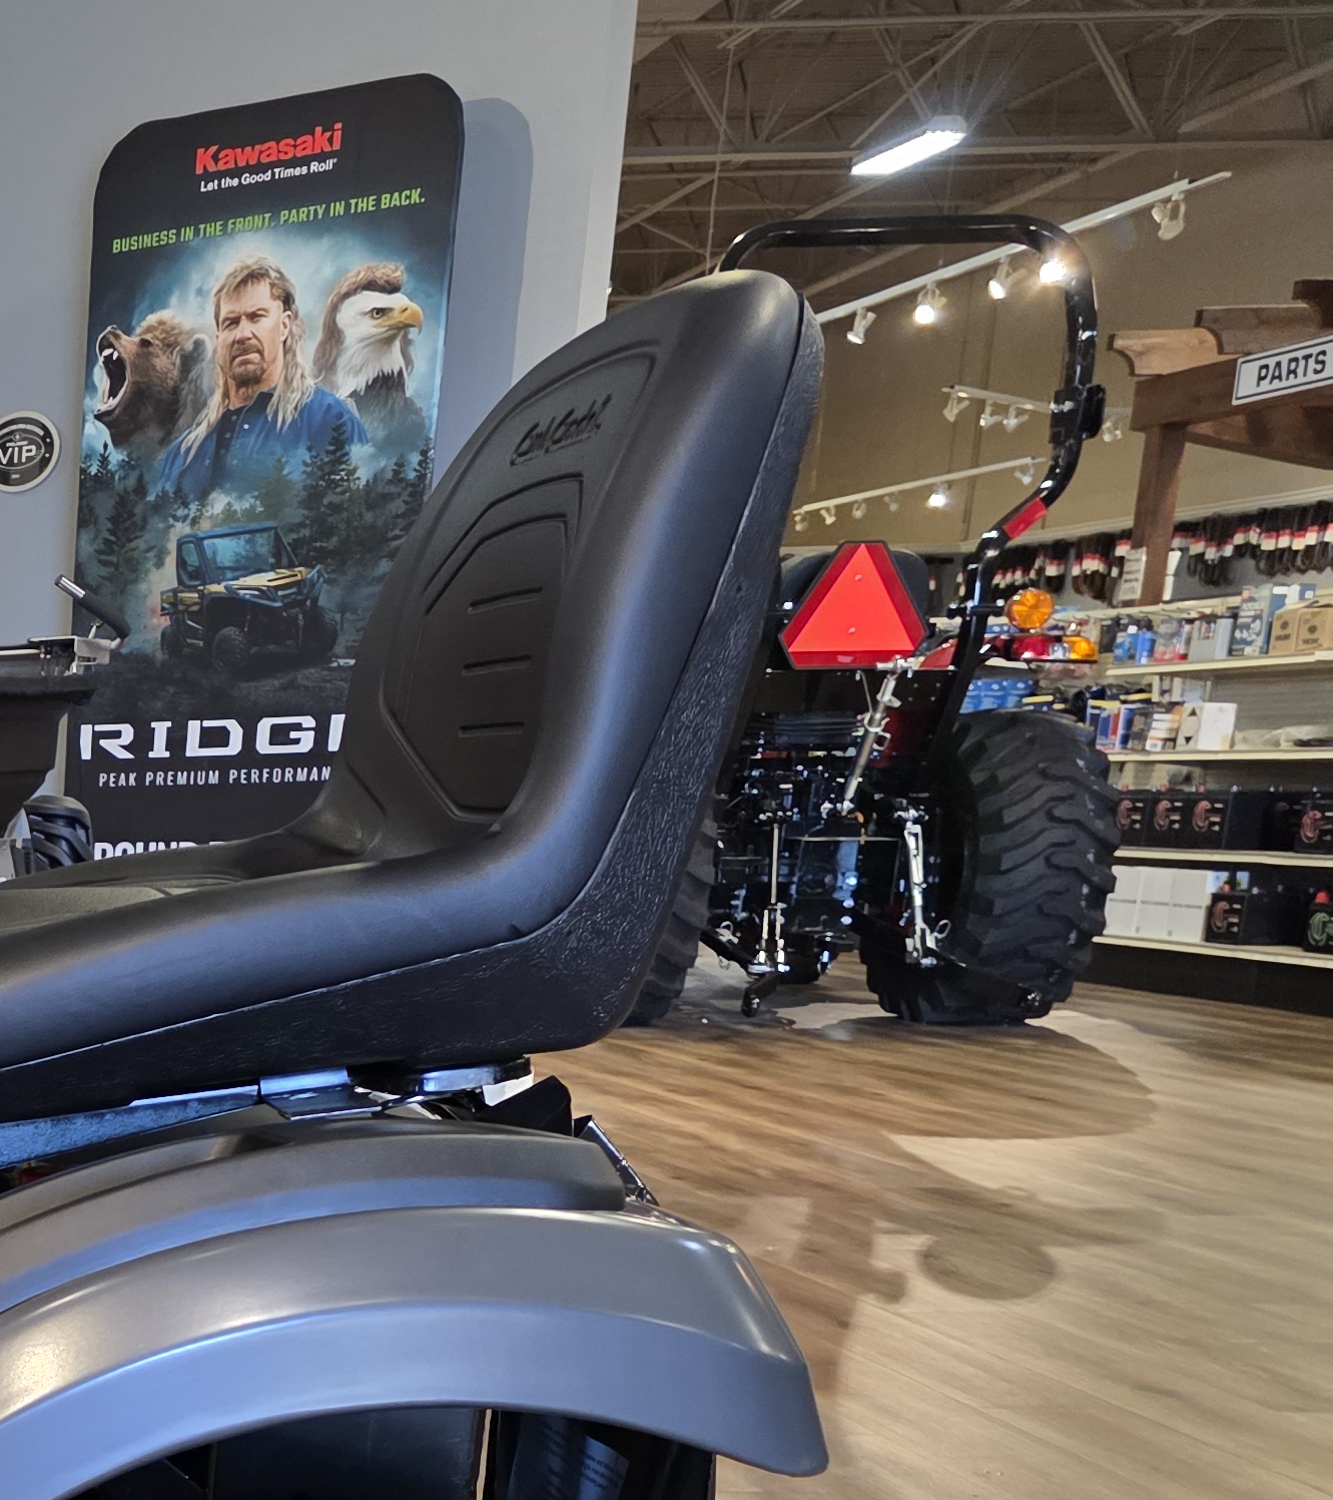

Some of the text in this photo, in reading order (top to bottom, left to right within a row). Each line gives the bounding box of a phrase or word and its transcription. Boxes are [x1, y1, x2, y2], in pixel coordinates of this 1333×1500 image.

[195, 123, 343, 175] Kawasaki
[200, 159, 335, 193] Let the Good Times Roll
[112, 229, 177, 254] BUSINESS
[180, 226, 195, 242] IN
[198, 221, 223, 239] THE
[280, 203, 326, 225] PARTY
[329, 200, 345, 217] IN
[349, 196, 377, 214] THE
[380, 187, 426, 210] BACK.
[1255, 349, 1328, 388] PARTS
[99, 772, 137, 787] PEAK
[145, 769, 220, 786] PREMIUM
